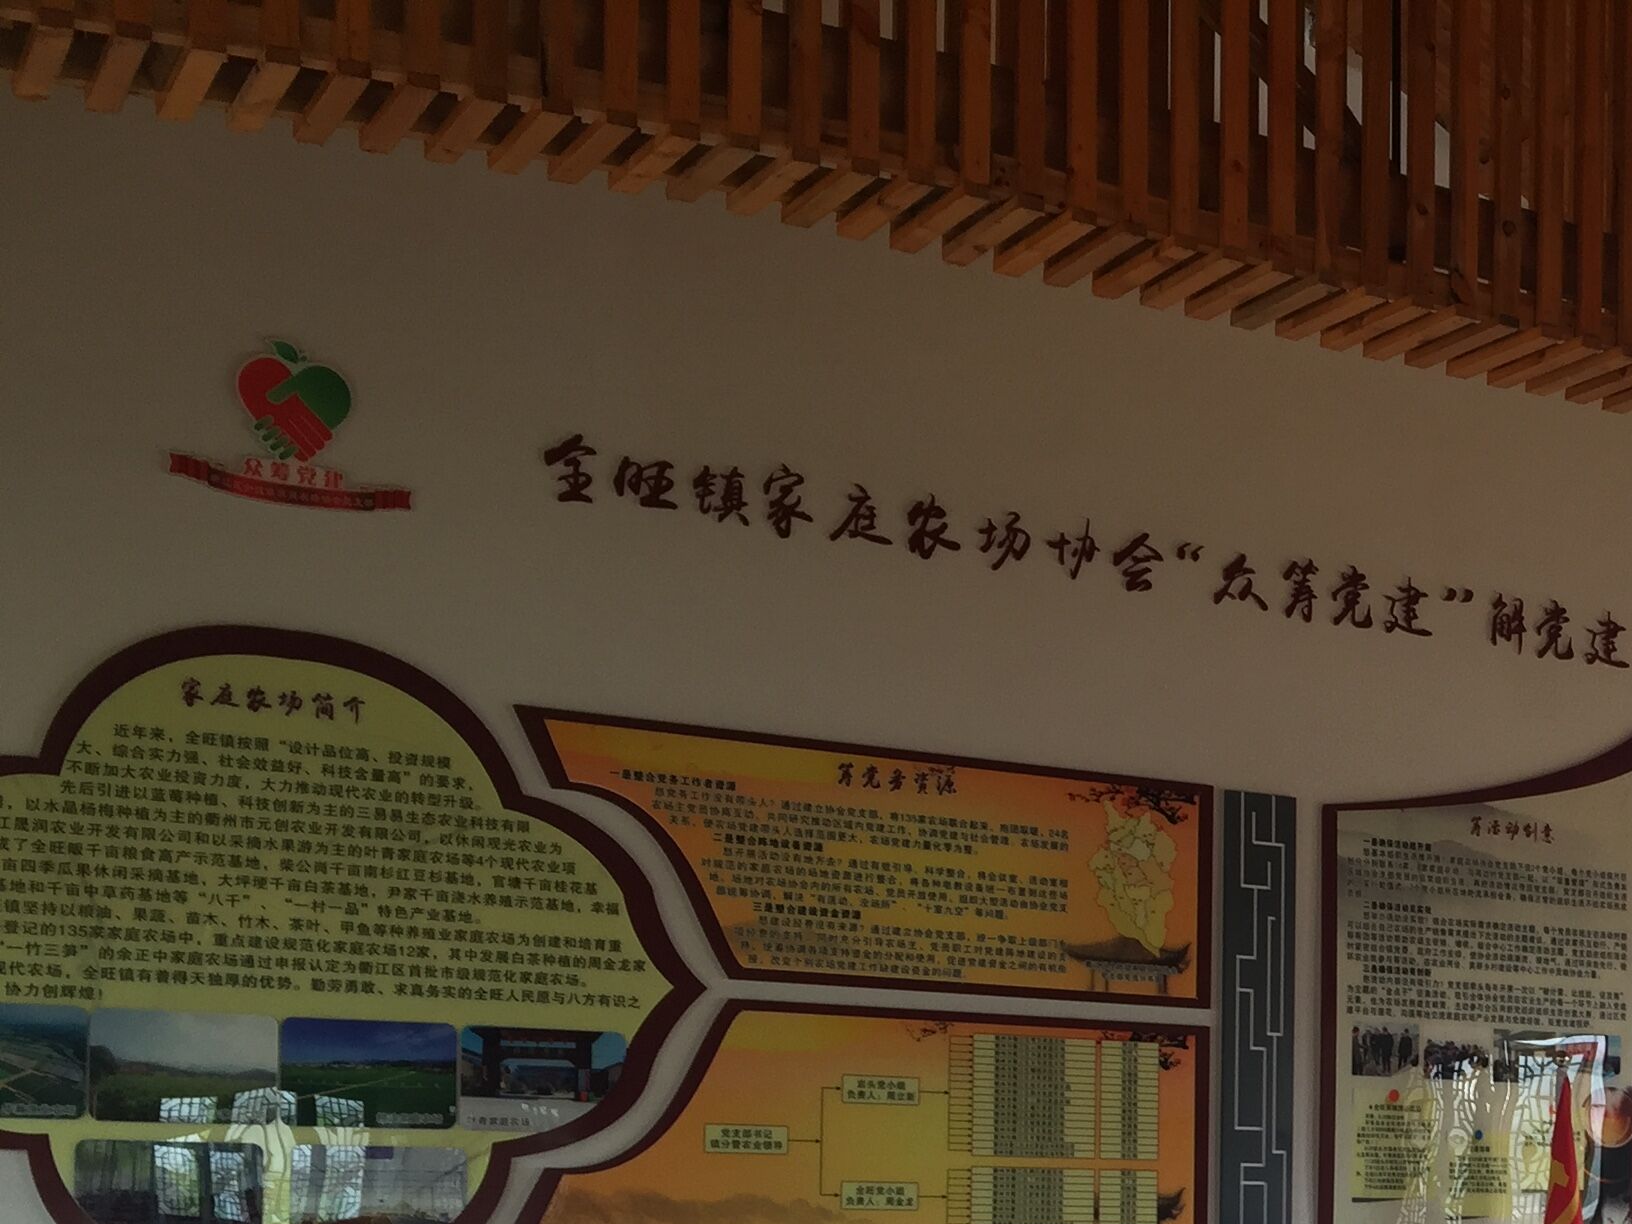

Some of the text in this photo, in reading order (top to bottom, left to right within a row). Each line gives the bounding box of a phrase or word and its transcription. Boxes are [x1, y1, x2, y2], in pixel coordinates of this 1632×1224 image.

[181, 677, 366, 727] 家庭农场简介
